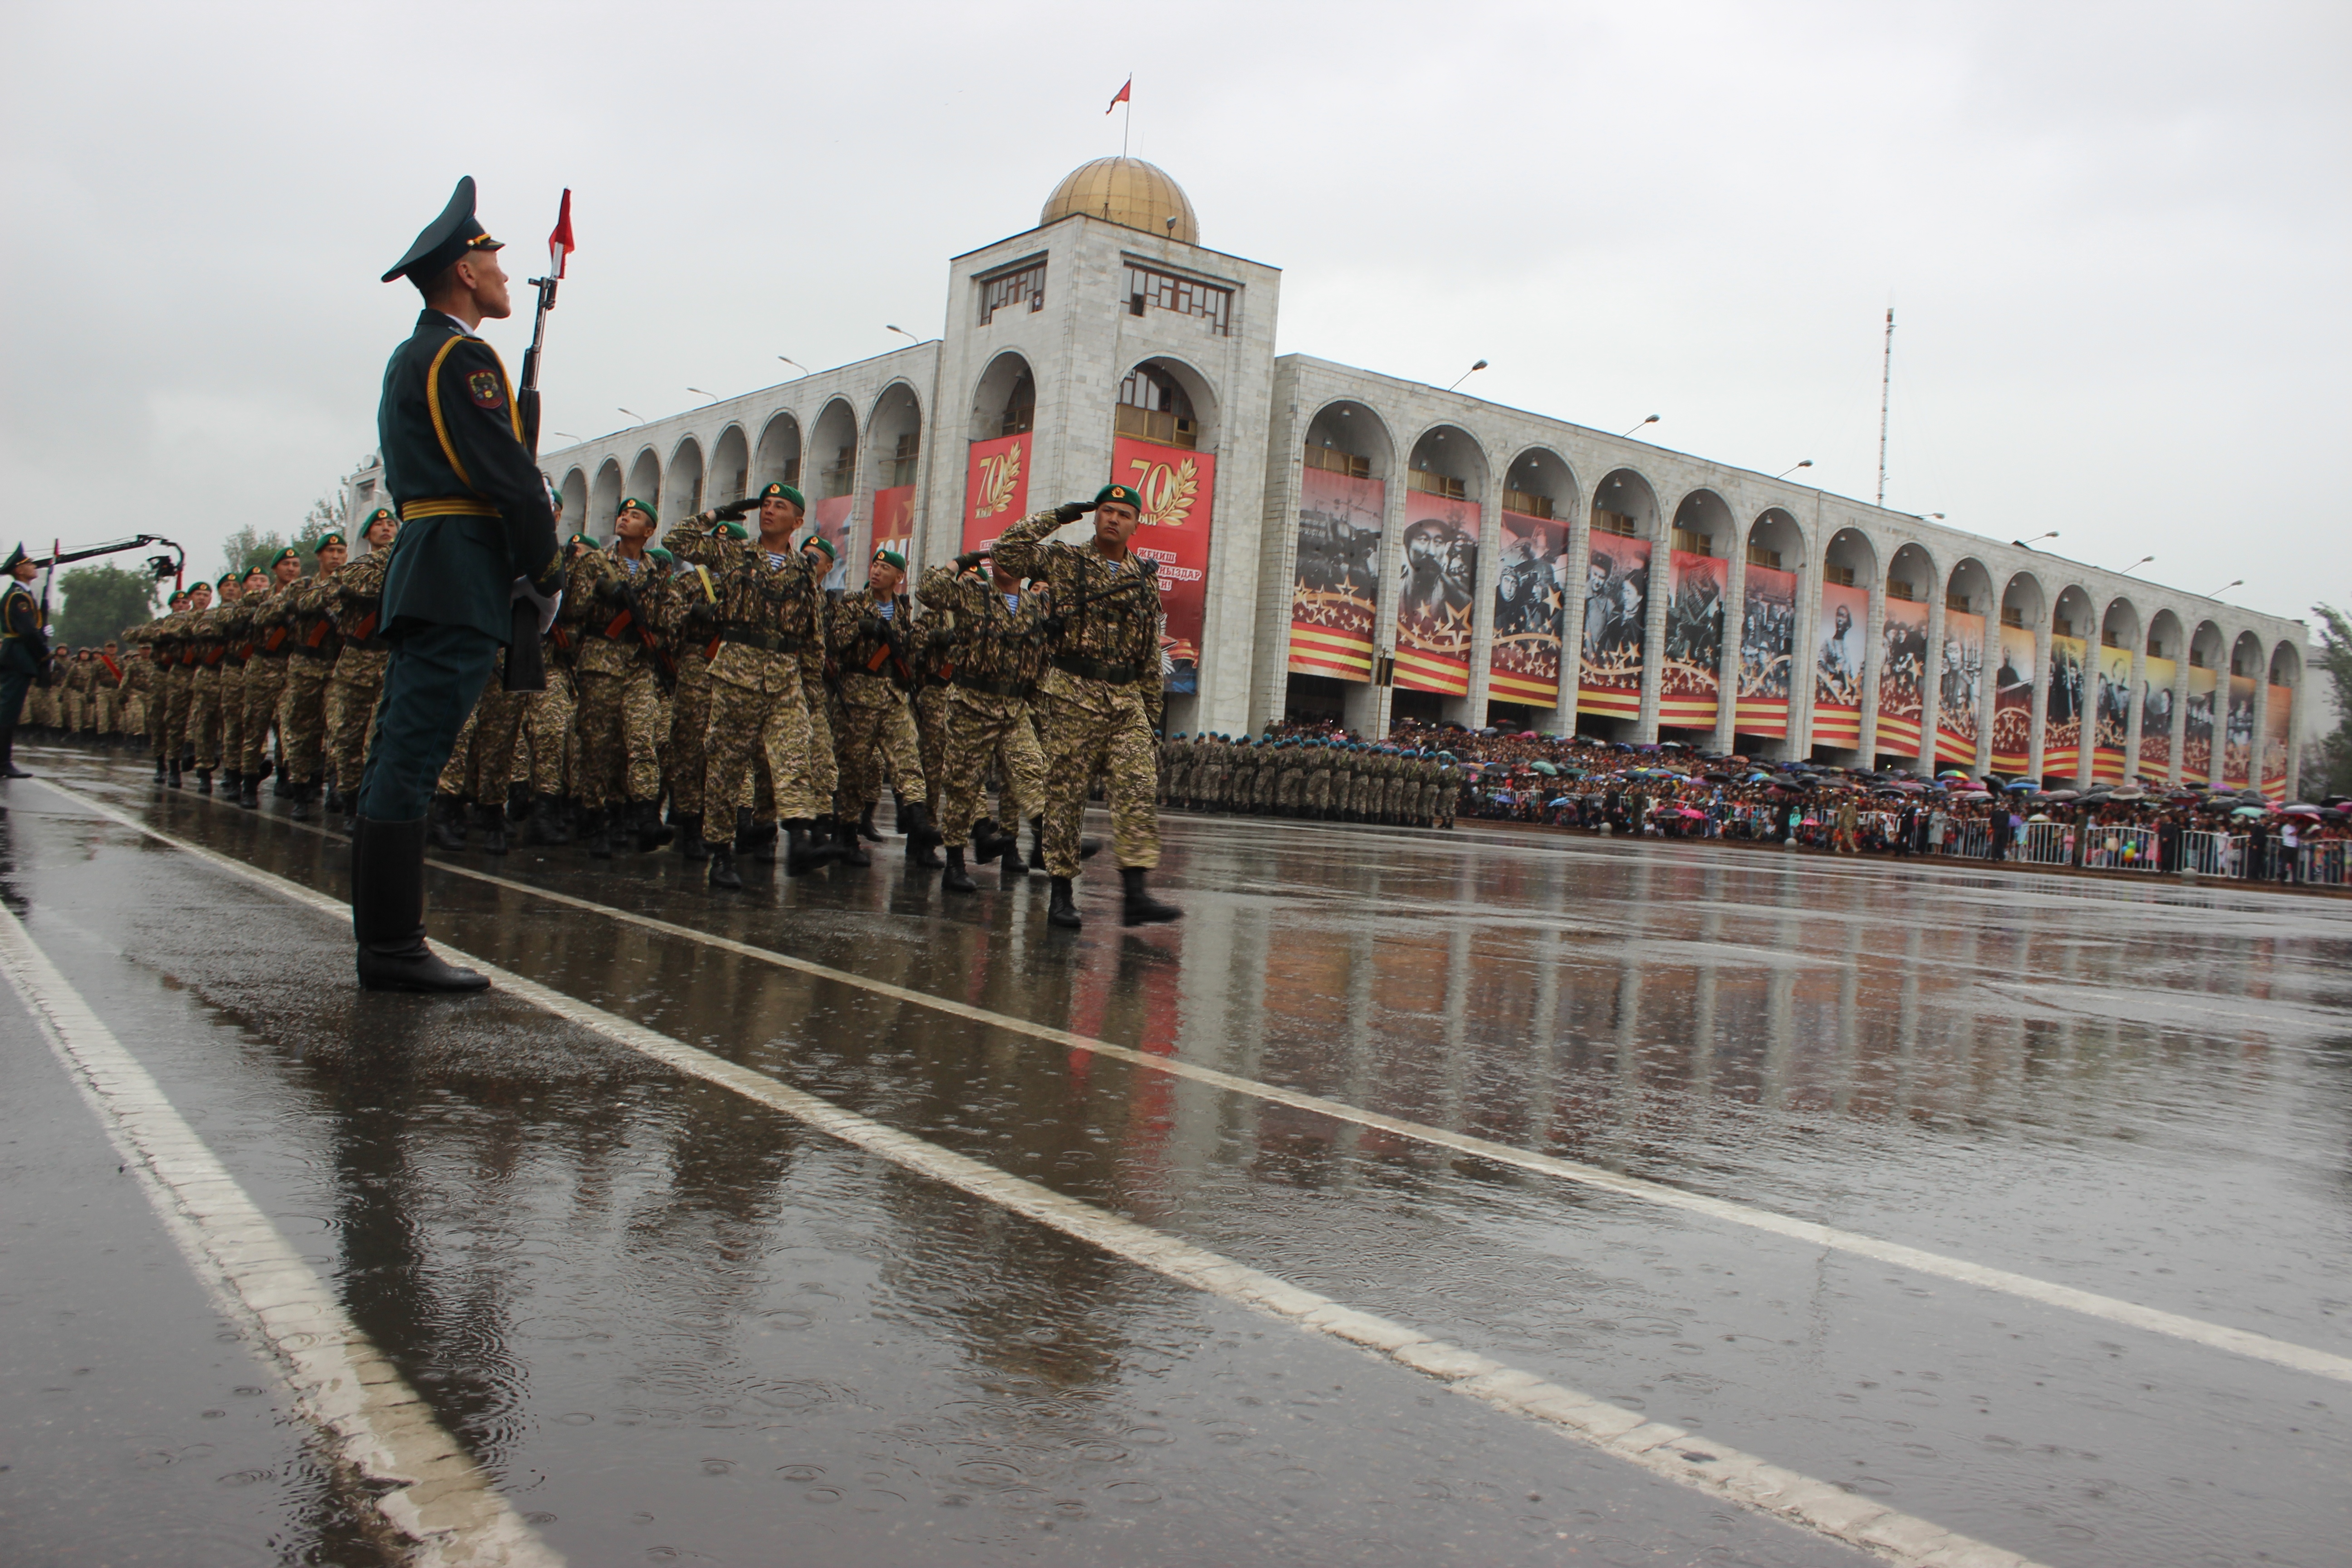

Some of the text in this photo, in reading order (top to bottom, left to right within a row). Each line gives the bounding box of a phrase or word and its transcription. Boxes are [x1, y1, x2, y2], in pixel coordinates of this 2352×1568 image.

[976, 454, 1005, 505] 70
[1130, 459, 1173, 513] 70
[1137, 512, 1157, 526] ЫЛ
